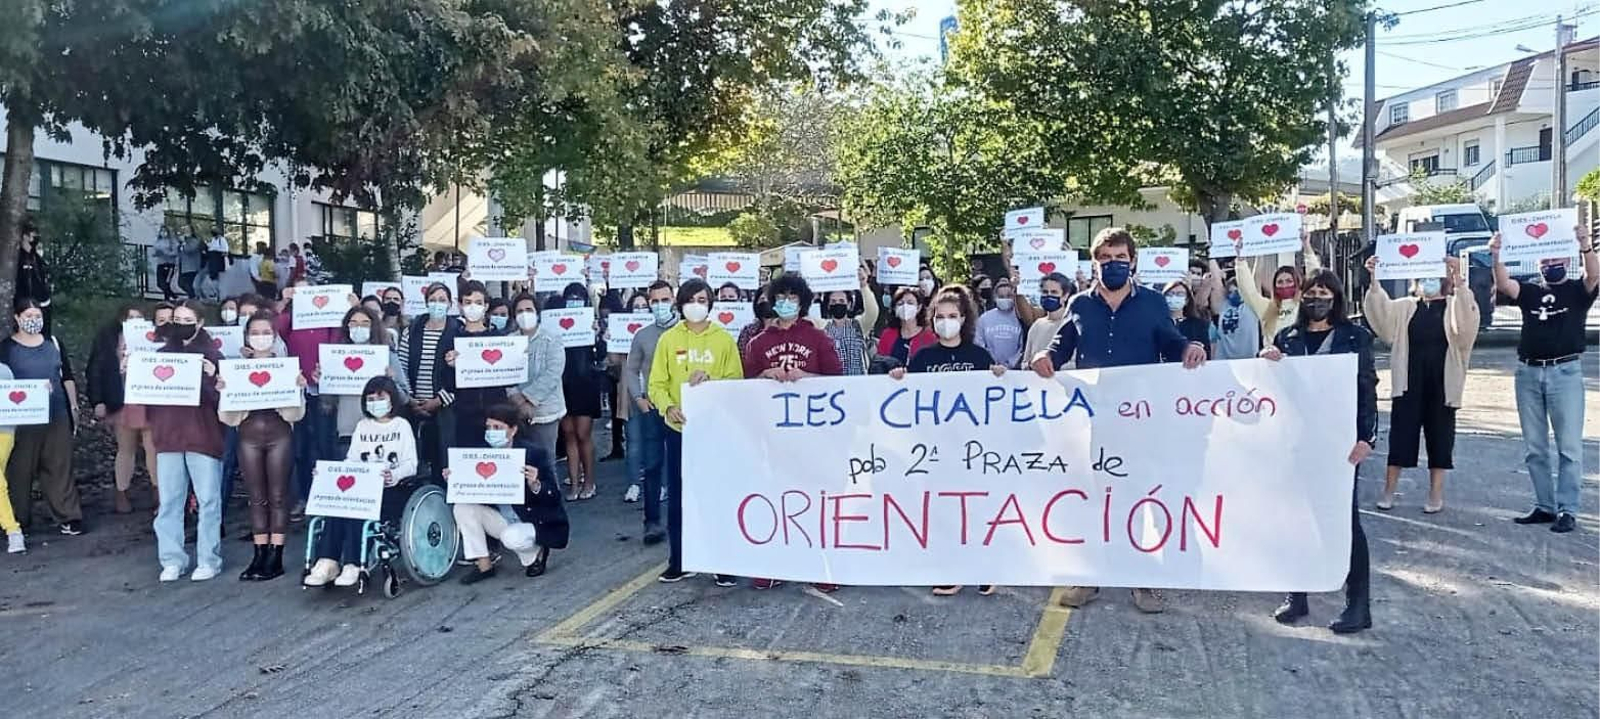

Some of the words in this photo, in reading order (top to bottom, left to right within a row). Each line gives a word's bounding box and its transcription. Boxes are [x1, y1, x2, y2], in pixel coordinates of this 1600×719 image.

[676, 348, 715, 365] FILA
[765, 343, 786, 359] NEW
[788, 342, 813, 359] YORK
[772, 389, 846, 428] IES
[879, 386, 1095, 429] CHAPELA
[1118, 400, 1151, 420] en
[1175, 387, 1277, 418] acción
[962, 440, 1069, 475] PRAZA
[1092, 447, 1129, 478] de
